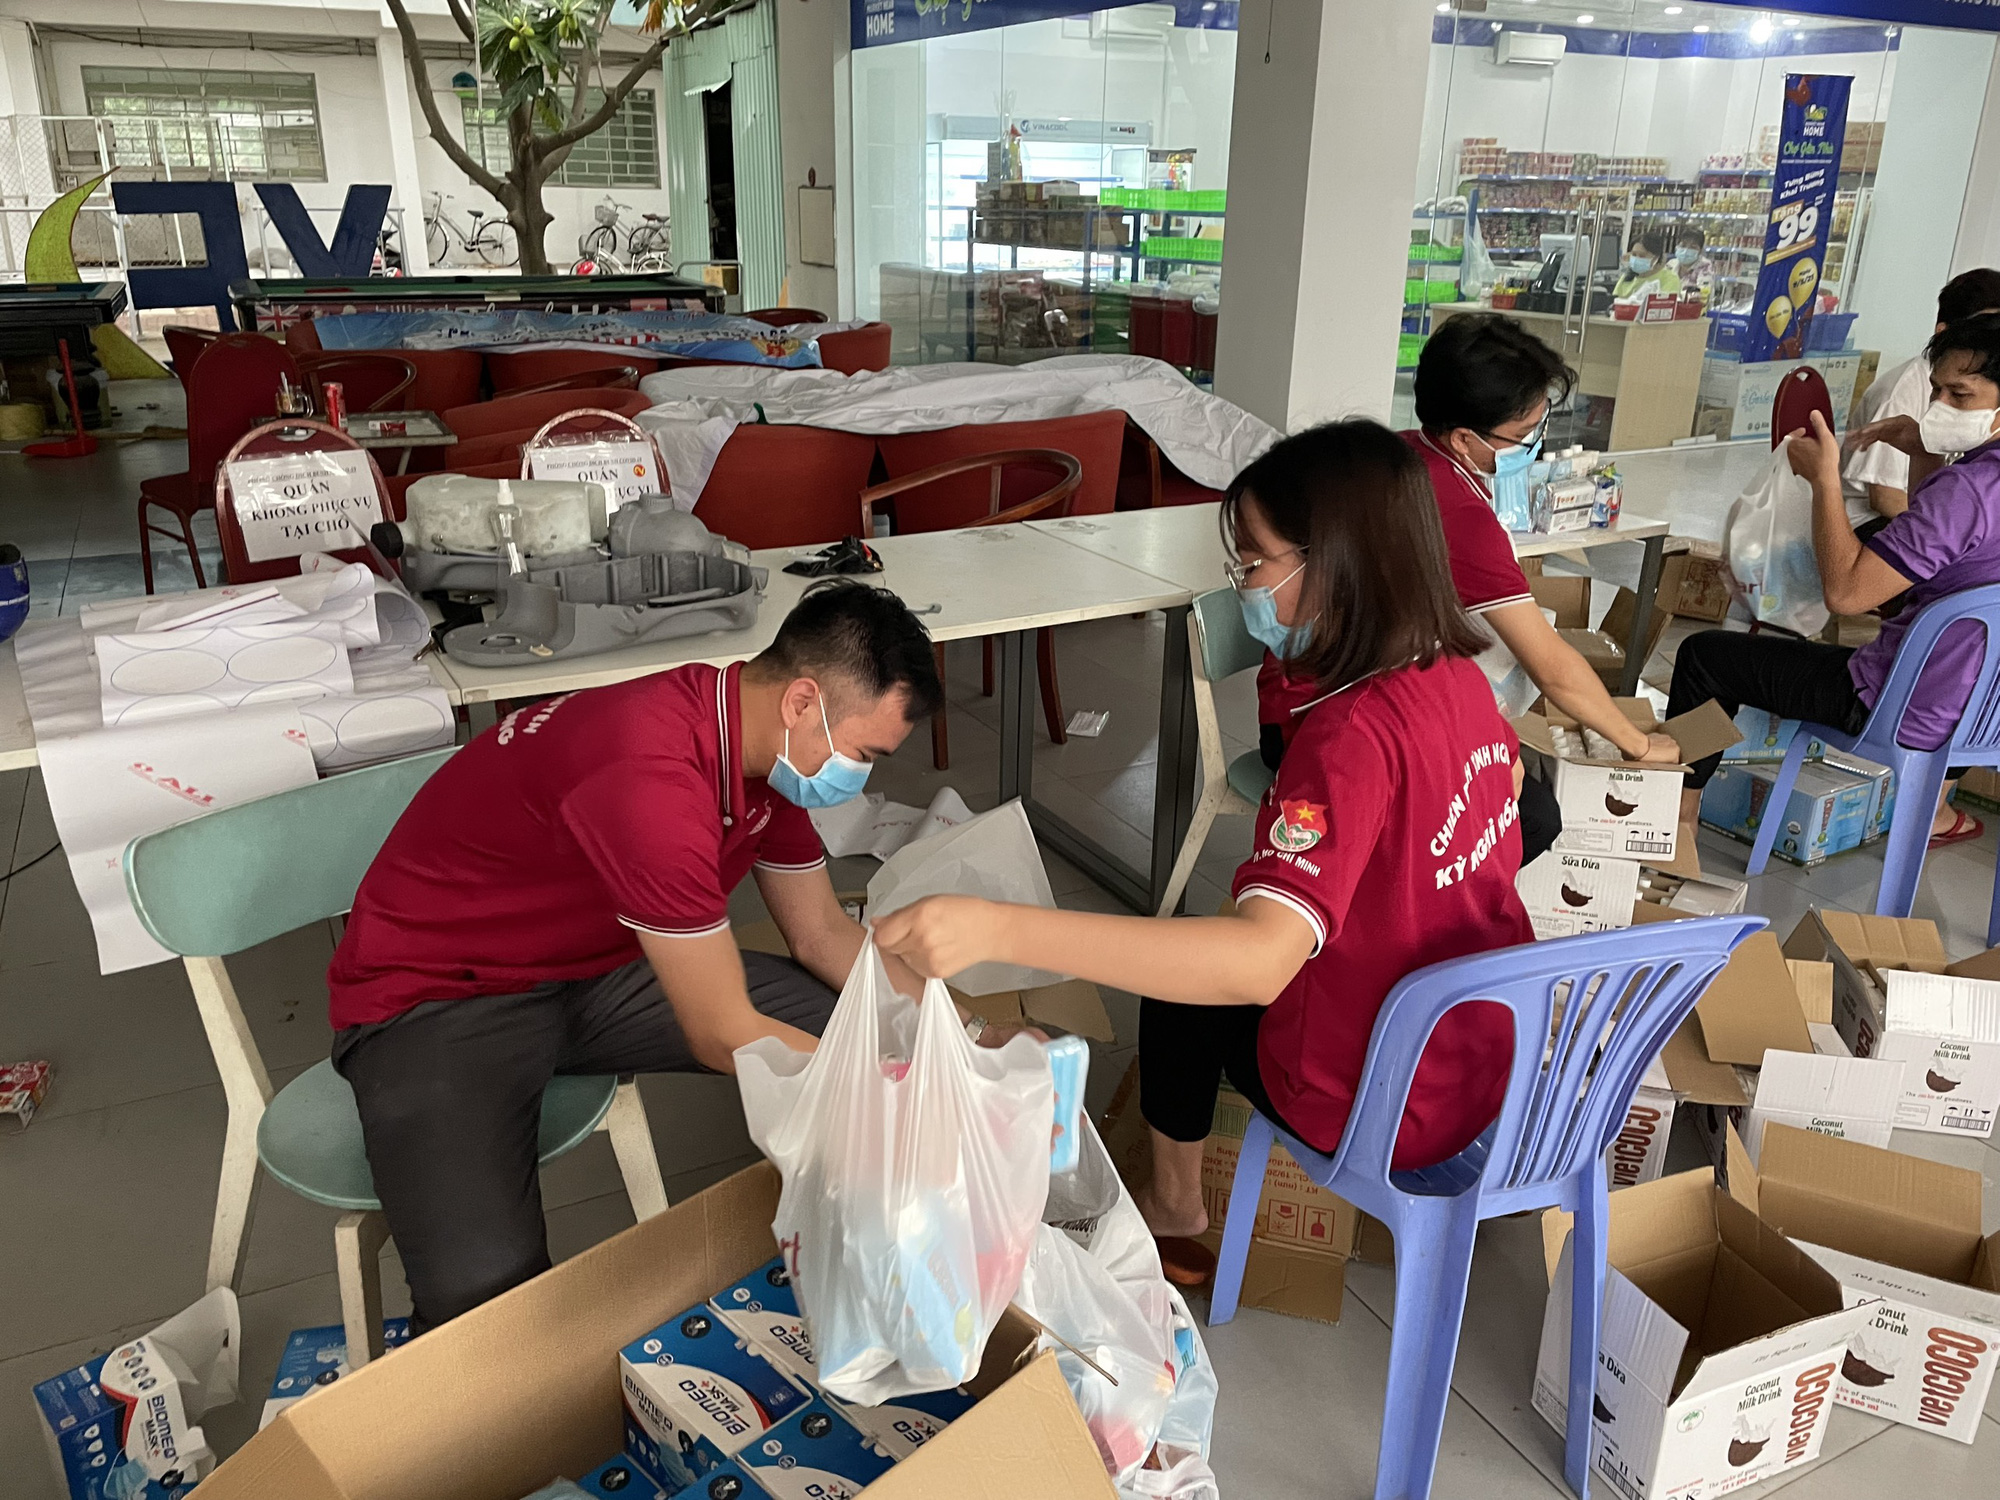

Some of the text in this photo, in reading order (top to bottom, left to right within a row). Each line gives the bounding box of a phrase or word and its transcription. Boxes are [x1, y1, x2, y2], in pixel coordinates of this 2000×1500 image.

[866, 12, 894, 37] HOME
[1803, 125, 1825, 137] HOME
[1777, 206, 1819, 250] 99
[578, 467, 618, 482] QUÁN
[283, 480, 330, 499] QUÁN
[312, 498, 350, 514] PHỤC
[353, 496, 372, 509] VỤ
[280, 524, 311, 539] TẠI
[1609, 772, 1644, 782] Milk Drink
[1295, 855, 1321, 878] MINH
[1933, 1049, 1971, 1061] Milk Drink
[1939, 1041, 1969, 1052] Coconut
[1811, 1117, 1844, 1129] Coconut
[1875, 1317, 1909, 1336] Drink
[1745, 1376, 1781, 1398] Coconut
[1737, 1386, 1783, 1413] Milk Drink
